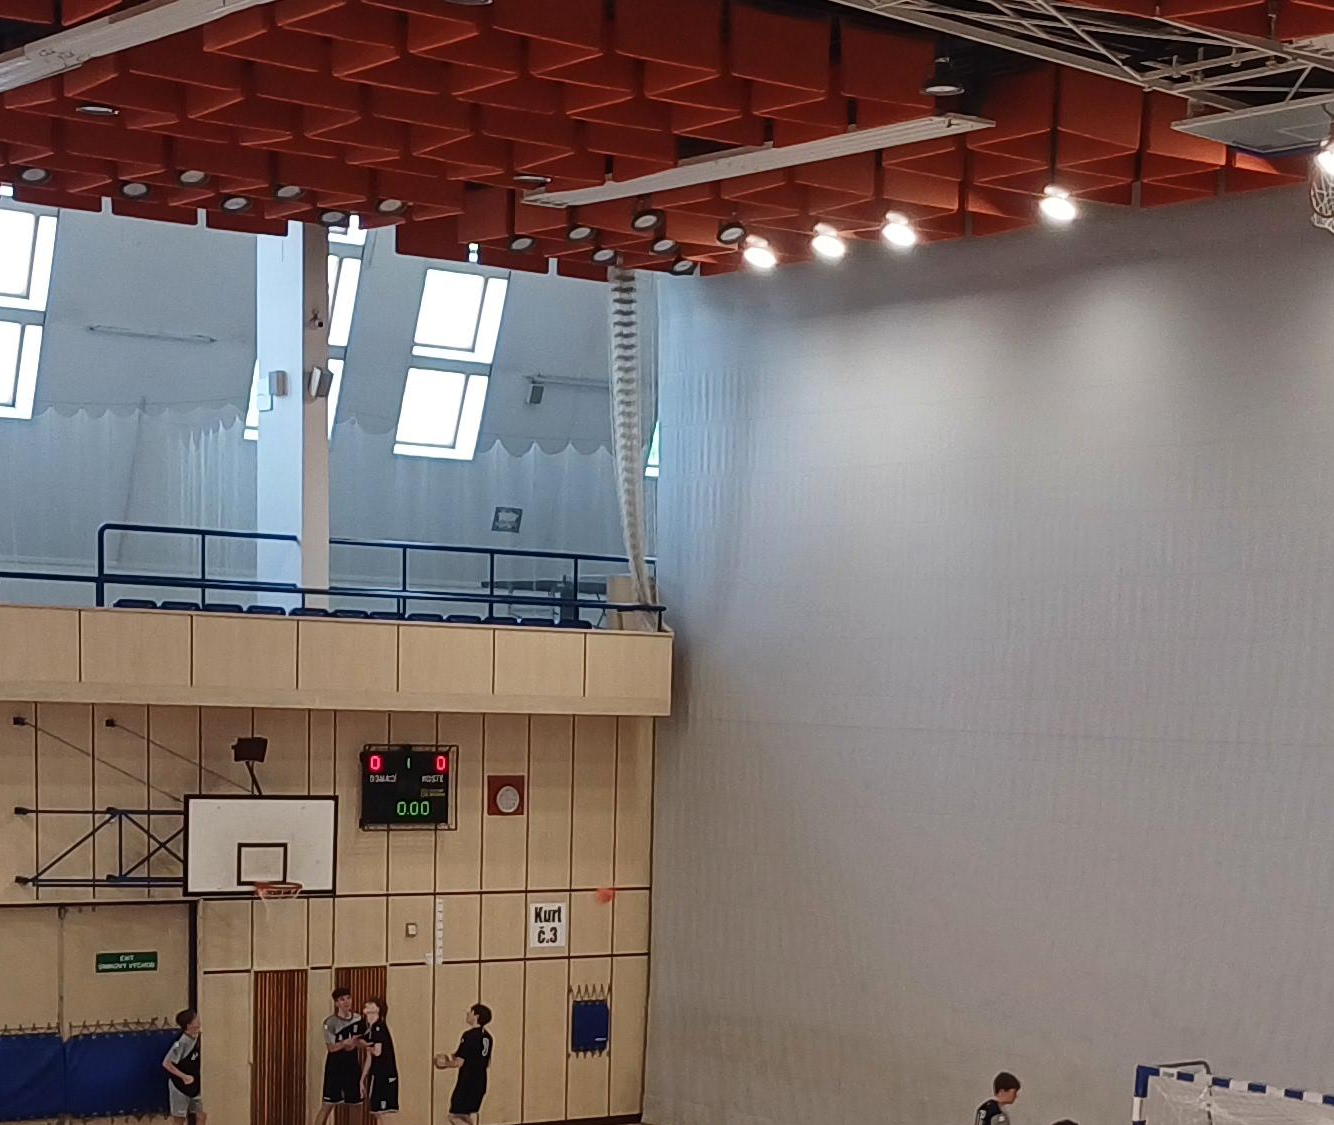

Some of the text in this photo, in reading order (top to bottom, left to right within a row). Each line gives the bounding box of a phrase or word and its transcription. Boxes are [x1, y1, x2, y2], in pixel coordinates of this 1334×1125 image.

[370, 755, 381, 771] 0
[436, 755, 446, 771] 0
[534, 905, 562, 923] Kurt
[537, 925, 558, 944] č.3
